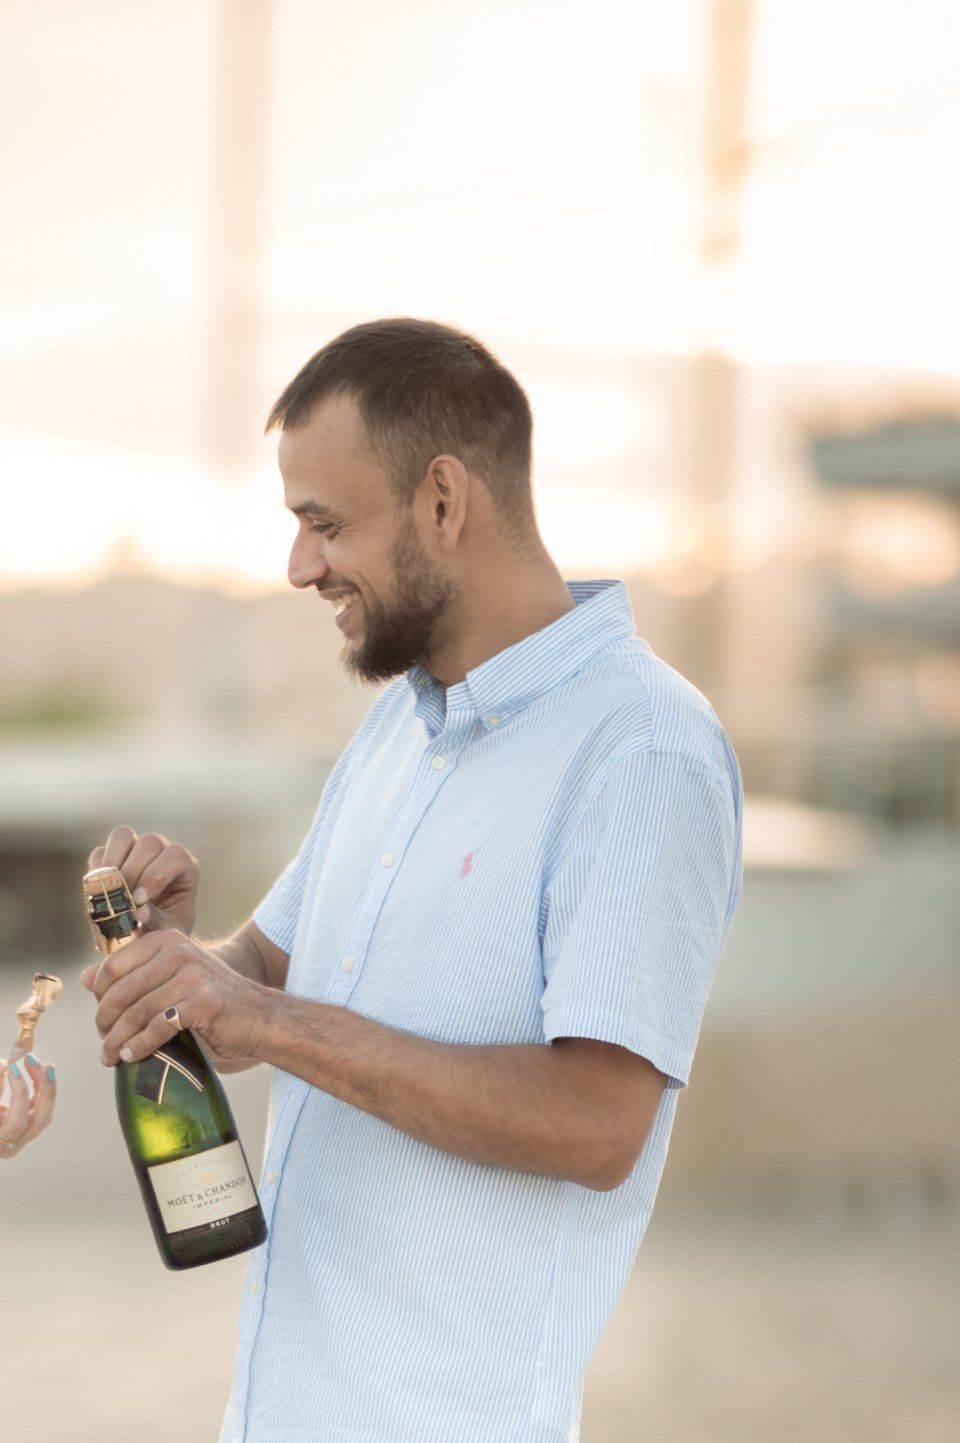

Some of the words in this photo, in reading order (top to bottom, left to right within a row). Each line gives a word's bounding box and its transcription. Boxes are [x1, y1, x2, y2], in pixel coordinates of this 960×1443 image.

[197, 1193, 204, 1201] &
[205, 1176, 247, 1198] CHANDON
[210, 1218, 231, 1229] BRUT
